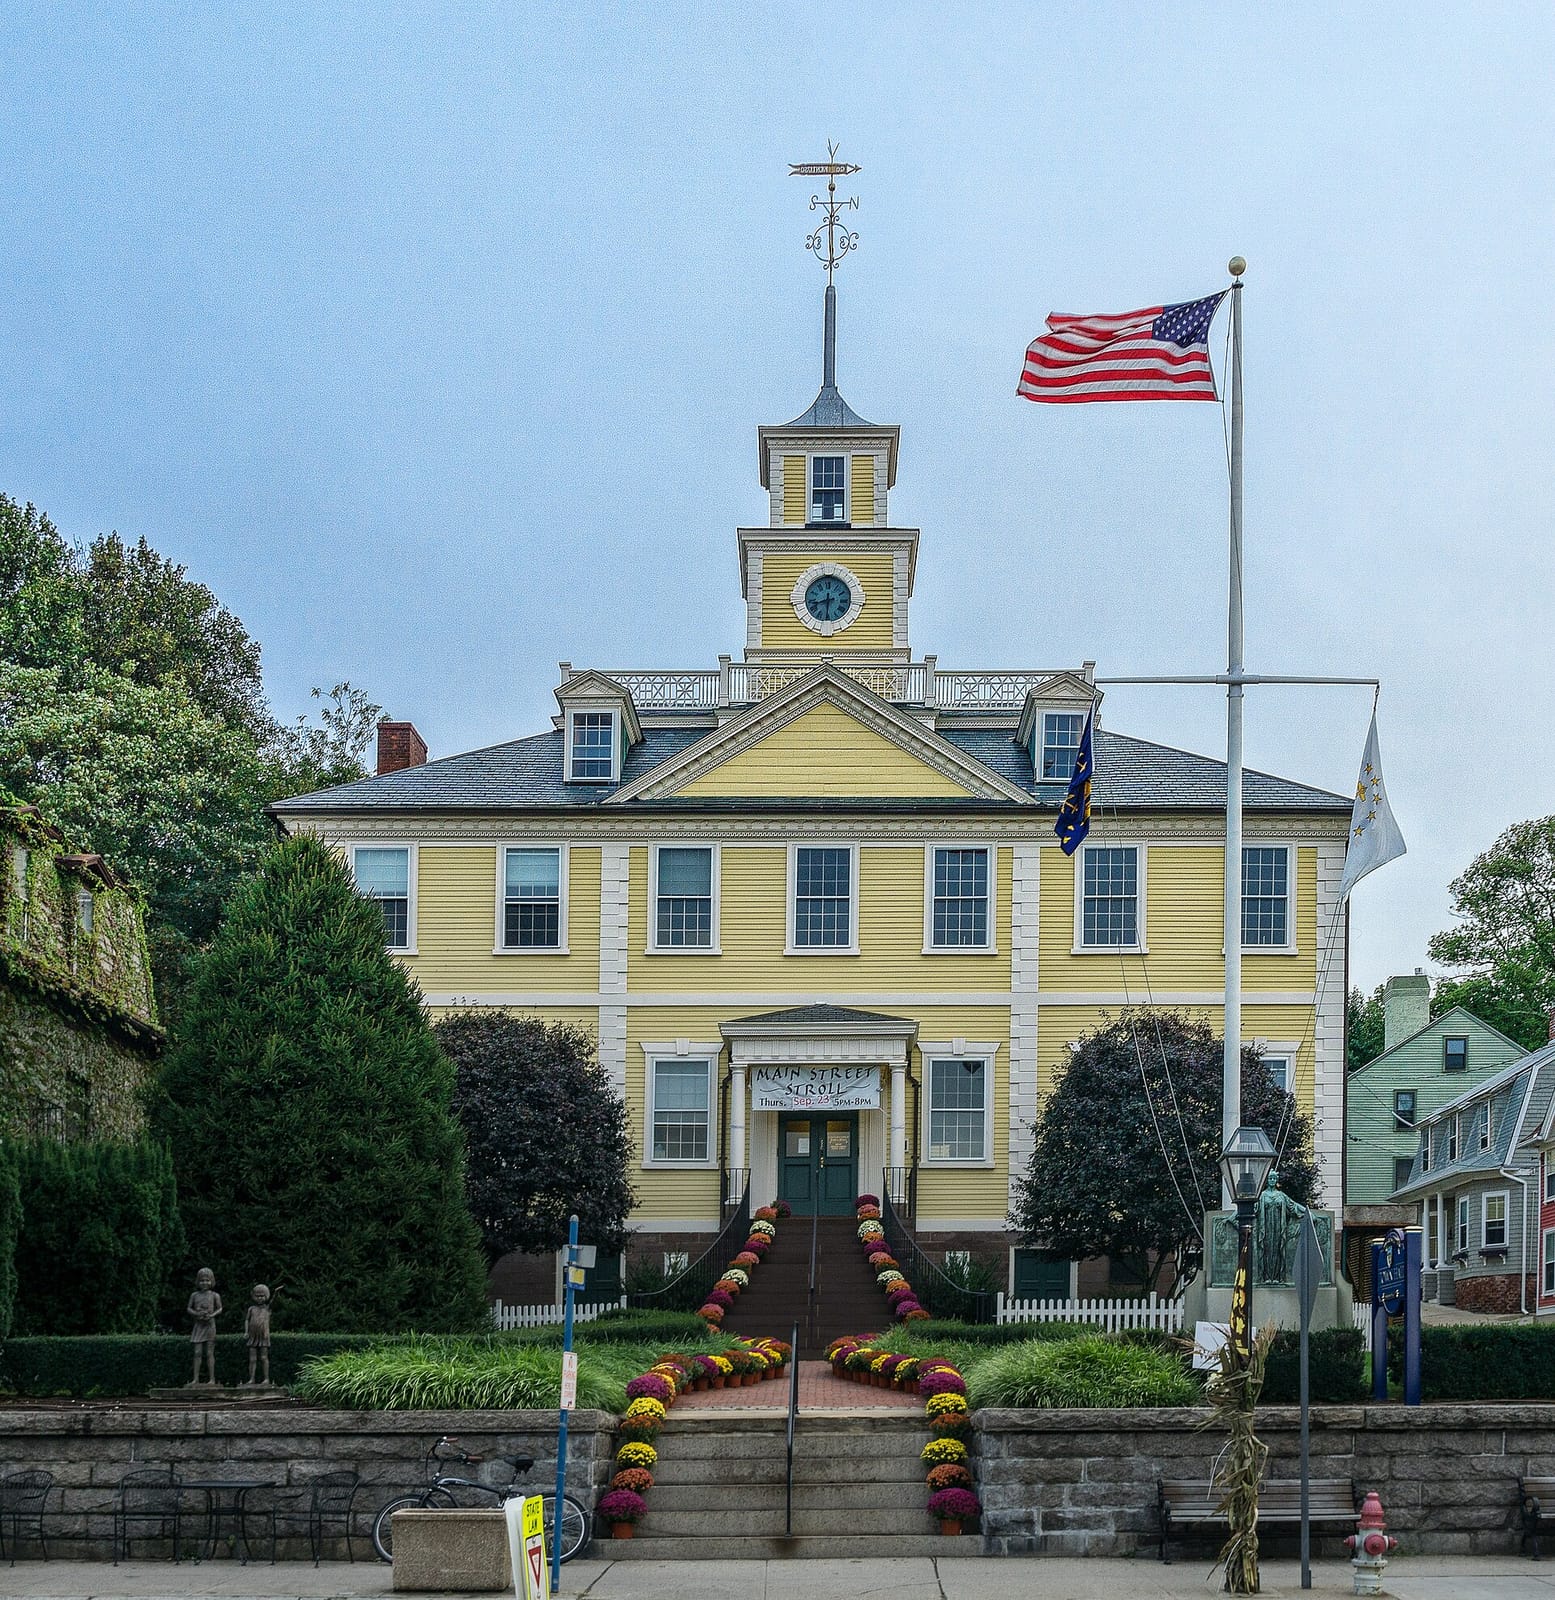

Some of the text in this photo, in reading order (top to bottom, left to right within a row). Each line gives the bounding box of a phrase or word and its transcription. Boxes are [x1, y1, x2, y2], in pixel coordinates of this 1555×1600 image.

[756, 1065, 877, 1081] MAIN STREET
[784, 1082, 848, 1096] STROLL
[760, 1095, 871, 1107] Thurs. Sep. 23 5PM-8PM
[526, 1501, 540, 1517] STATE
